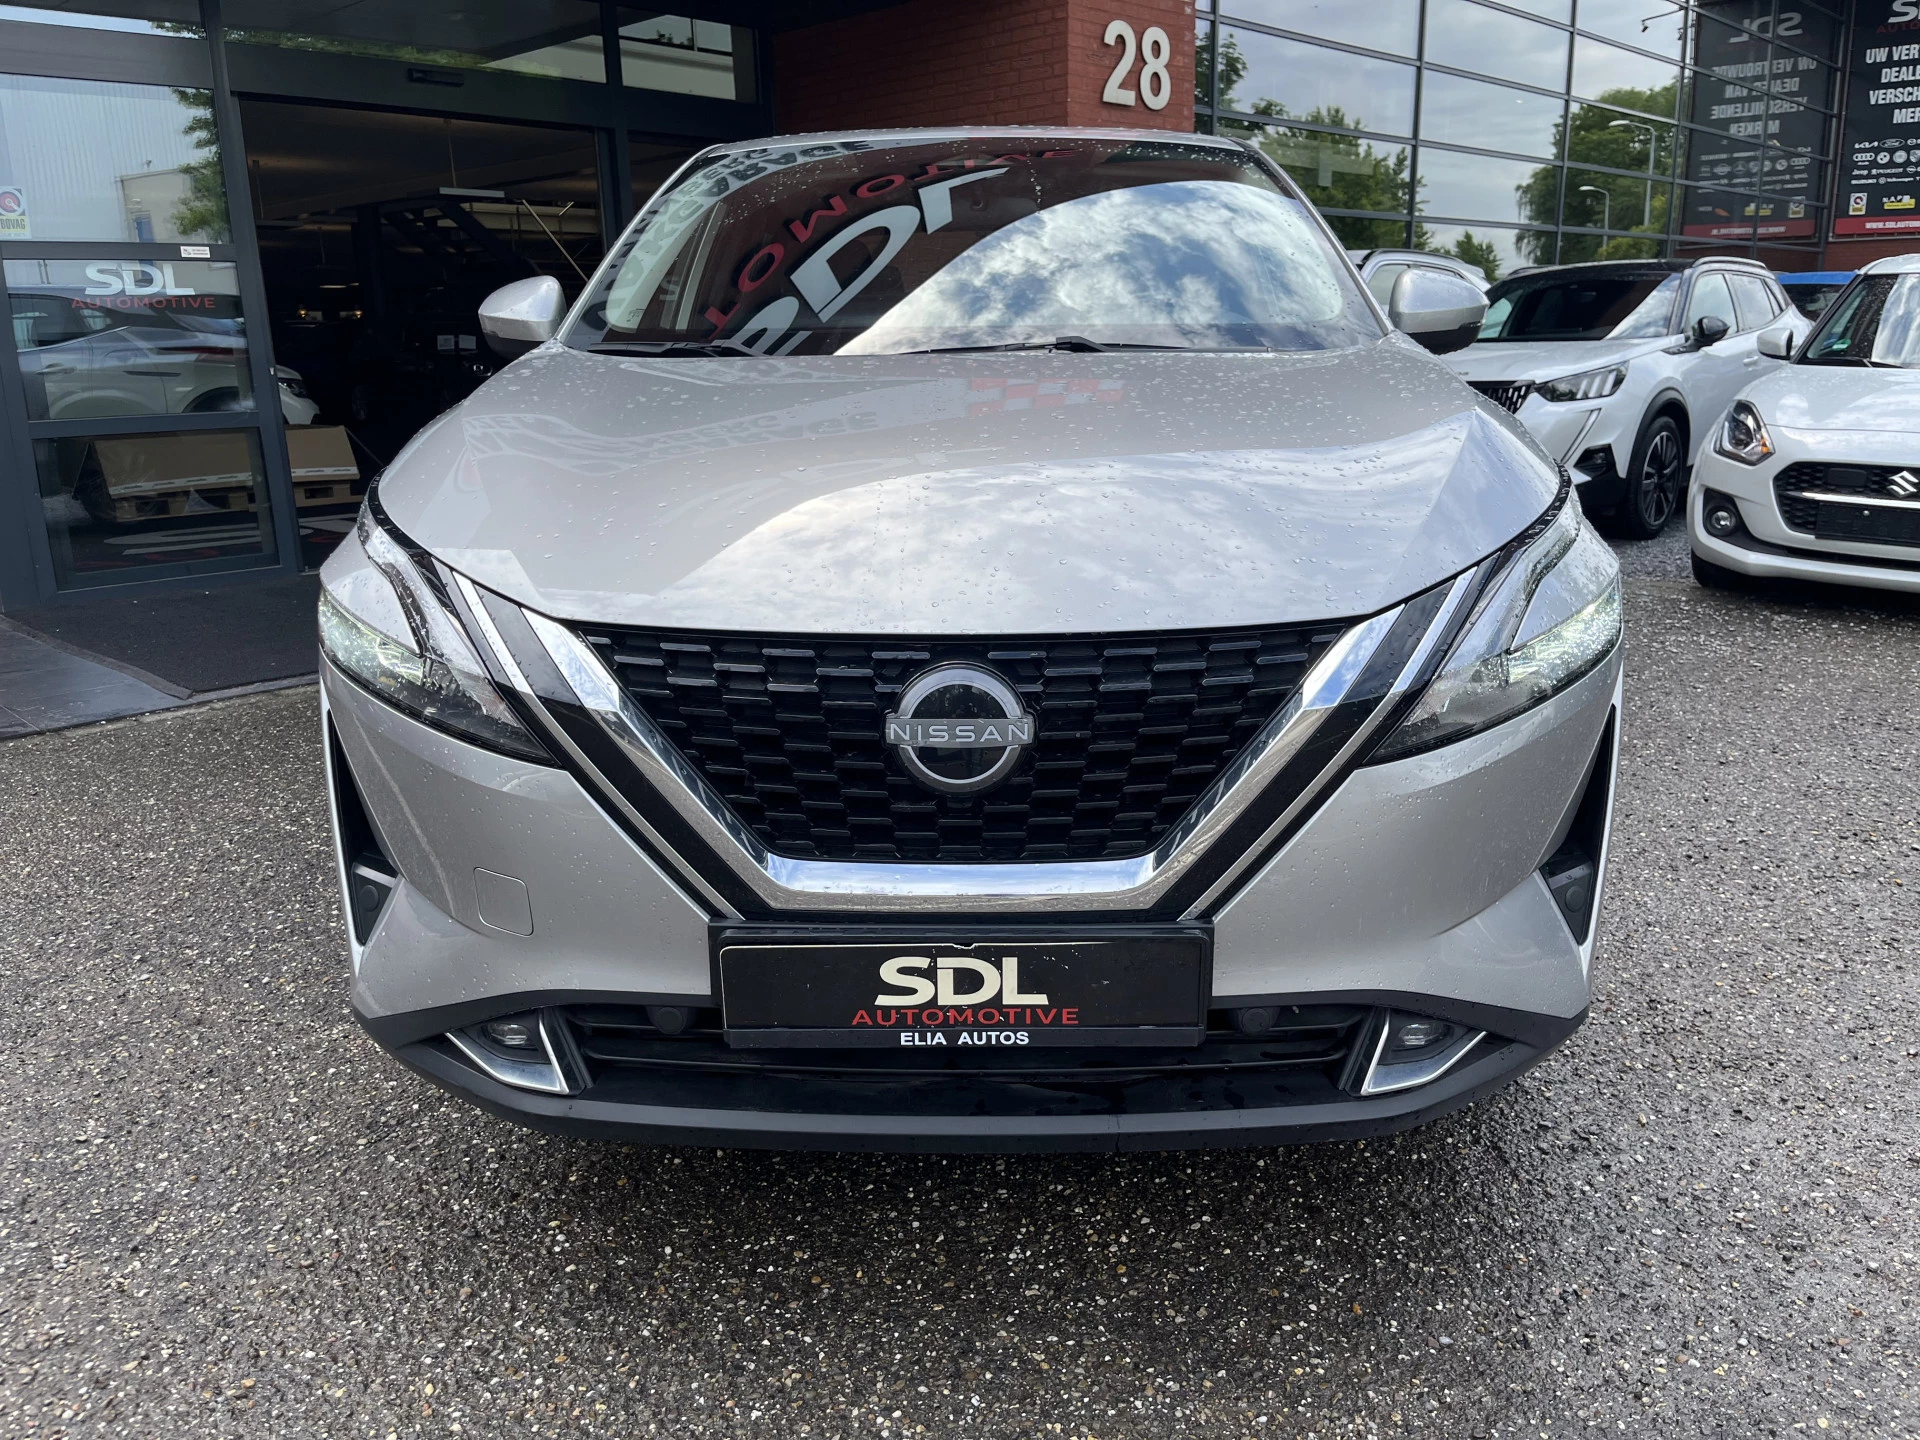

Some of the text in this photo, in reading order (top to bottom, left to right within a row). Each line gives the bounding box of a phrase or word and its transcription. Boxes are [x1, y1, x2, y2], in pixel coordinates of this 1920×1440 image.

[1887, 0, 1920, 23] S
[1865, 44, 1920, 64] UW VER
[1102, 19, 1172, 111] 28
[1869, 86, 1920, 105] VERSCH
[84, 262, 196, 296] SDL
[71, 297, 217, 309] AUTOMOTIVE
[890, 723, 1029, 742] NISSAN
[874, 956, 1049, 1006] SDL
[851, 1008, 1079, 1026] AUTOMOTIVE
[900, 1031, 1030, 1045] ELIA AUTOS
